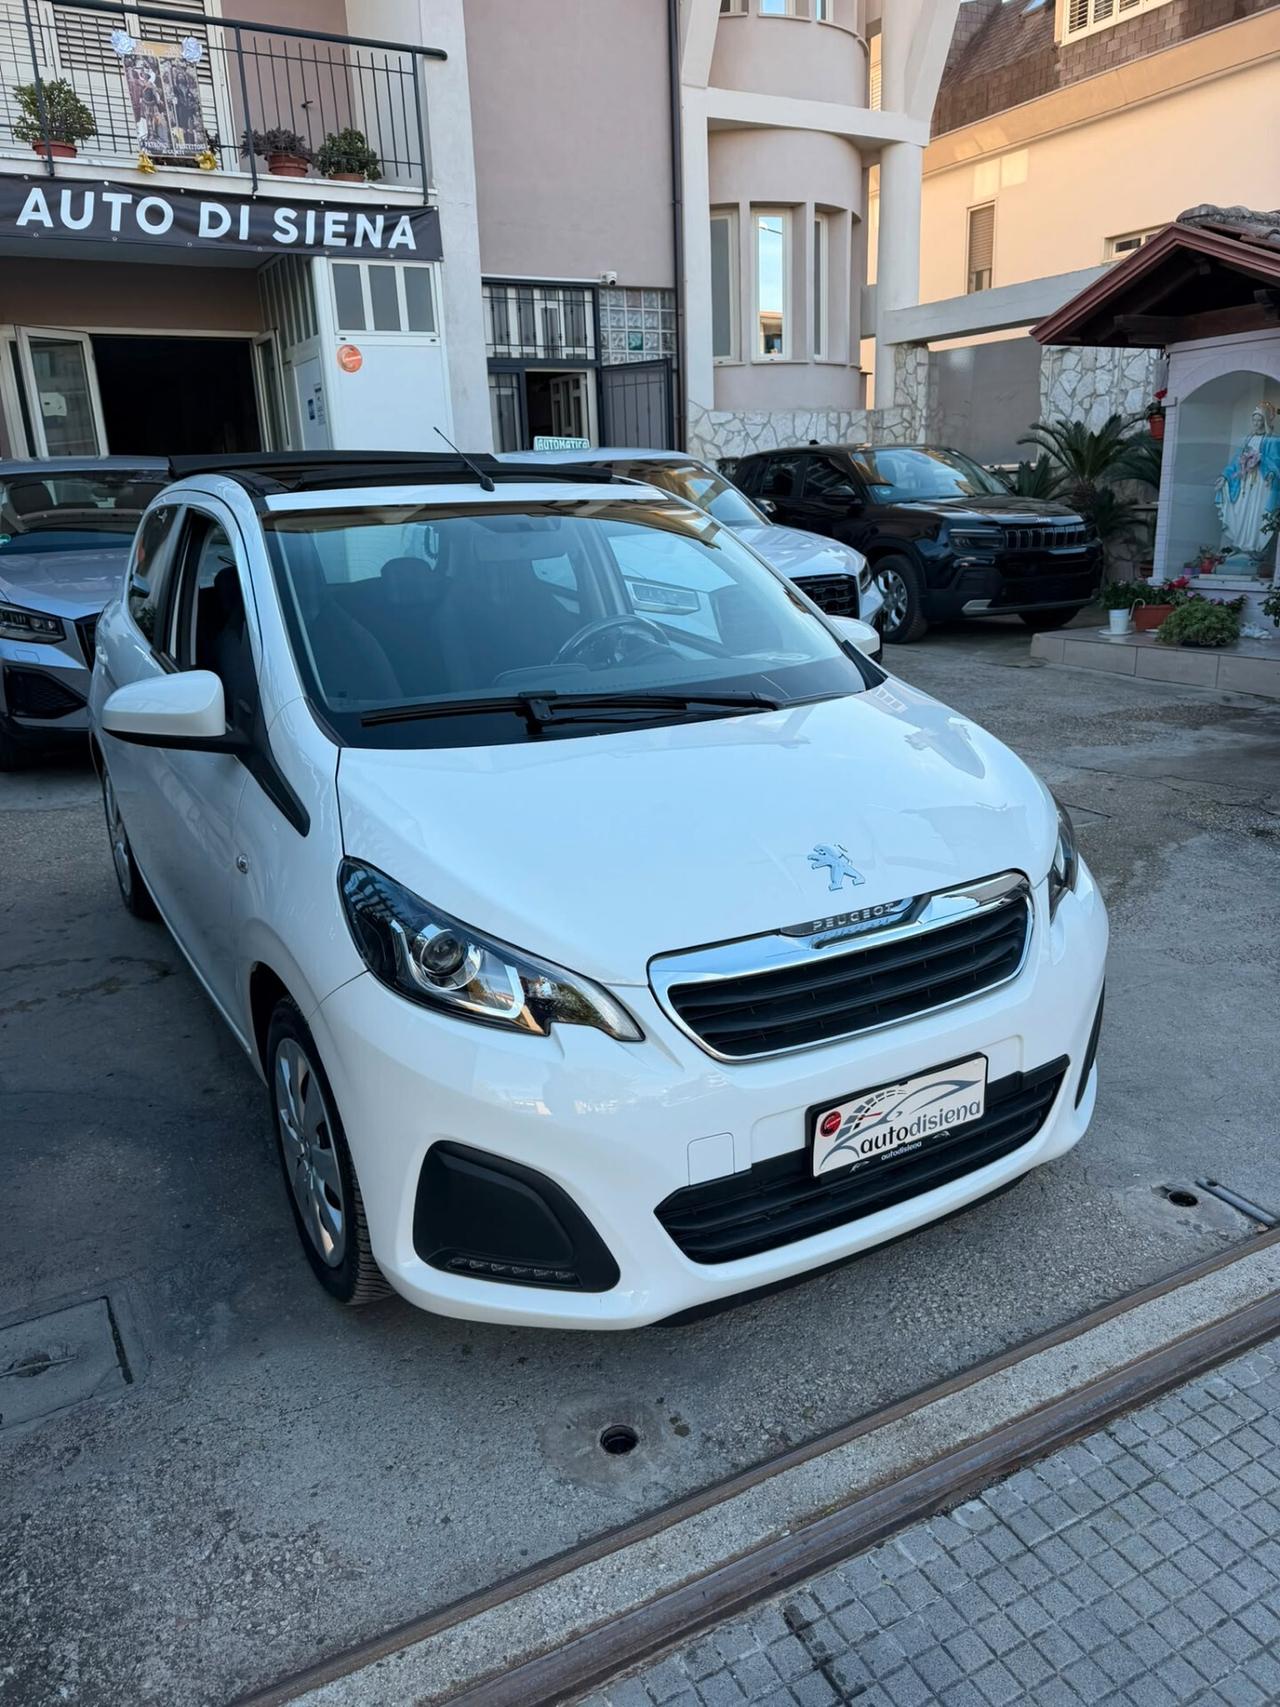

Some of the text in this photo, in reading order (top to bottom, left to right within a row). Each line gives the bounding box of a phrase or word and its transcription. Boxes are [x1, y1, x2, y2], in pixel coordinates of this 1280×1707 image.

[16, 187, 417, 250] AUTO DI SIENA
[812, 902, 894, 931] PEUGEOT
[860, 1099, 981, 1154] autodisiena
[881, 1141, 922, 1161] autodisiena
